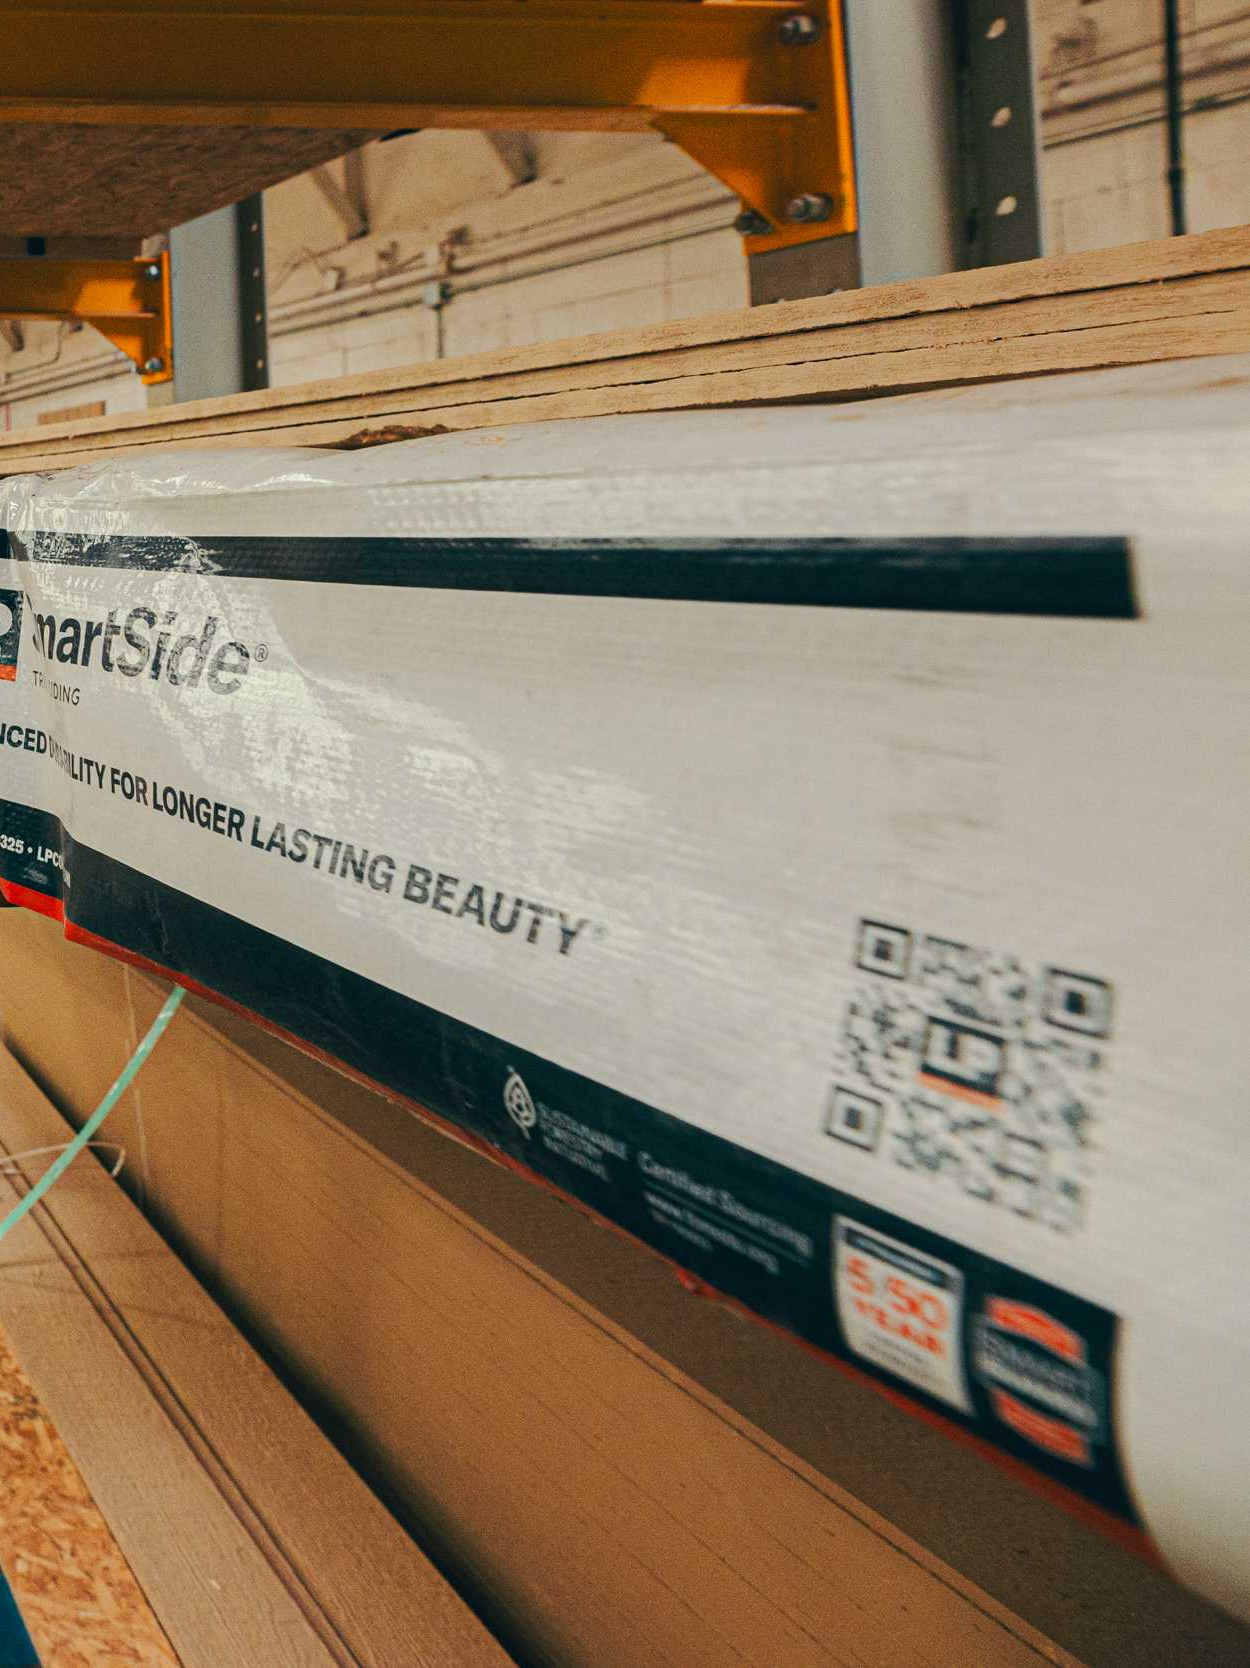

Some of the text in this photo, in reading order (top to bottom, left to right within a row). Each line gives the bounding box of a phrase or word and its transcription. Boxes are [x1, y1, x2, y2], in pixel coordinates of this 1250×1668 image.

[110, 767, 149, 806] FOR
[152, 781, 246, 842] LONGER
[250, 815, 397, 893] LASTING
